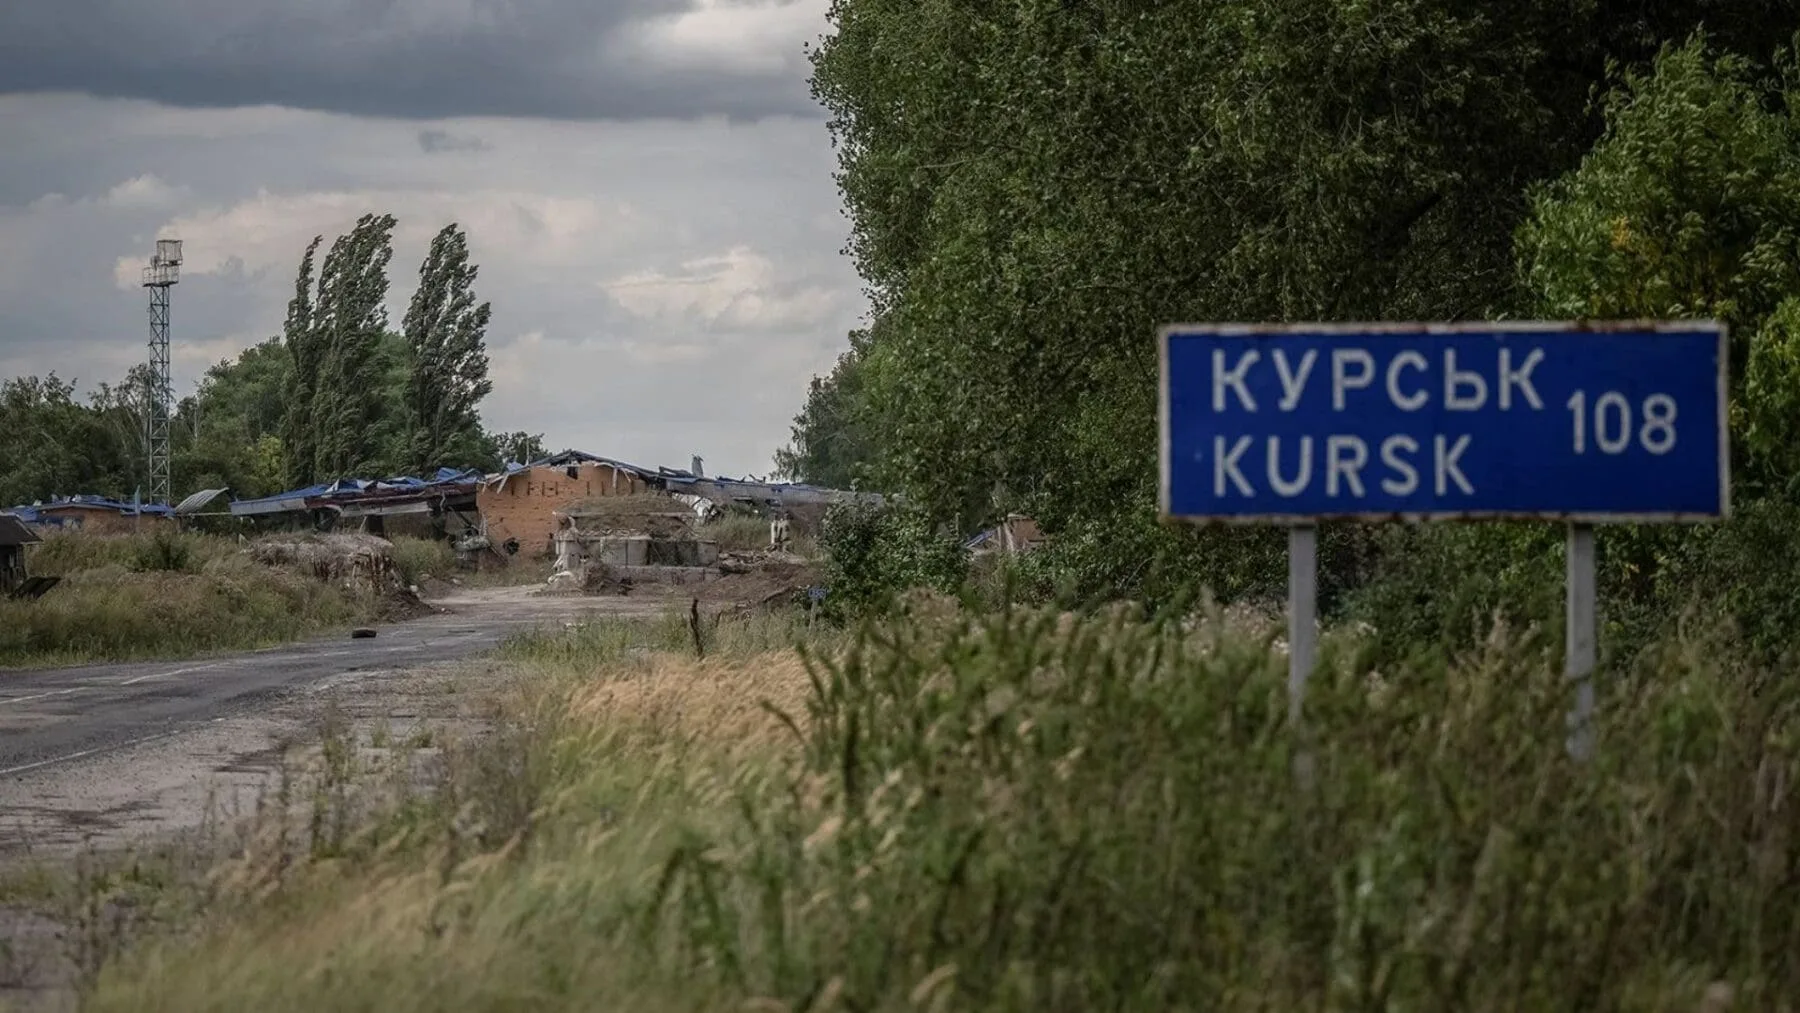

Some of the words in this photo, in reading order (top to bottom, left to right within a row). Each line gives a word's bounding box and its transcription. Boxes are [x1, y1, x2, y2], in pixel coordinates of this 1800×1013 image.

[1212, 349, 1545, 411] КУРСЬК
[1566, 390, 1678, 455] 108
[1214, 435, 1475, 497] KURSK
